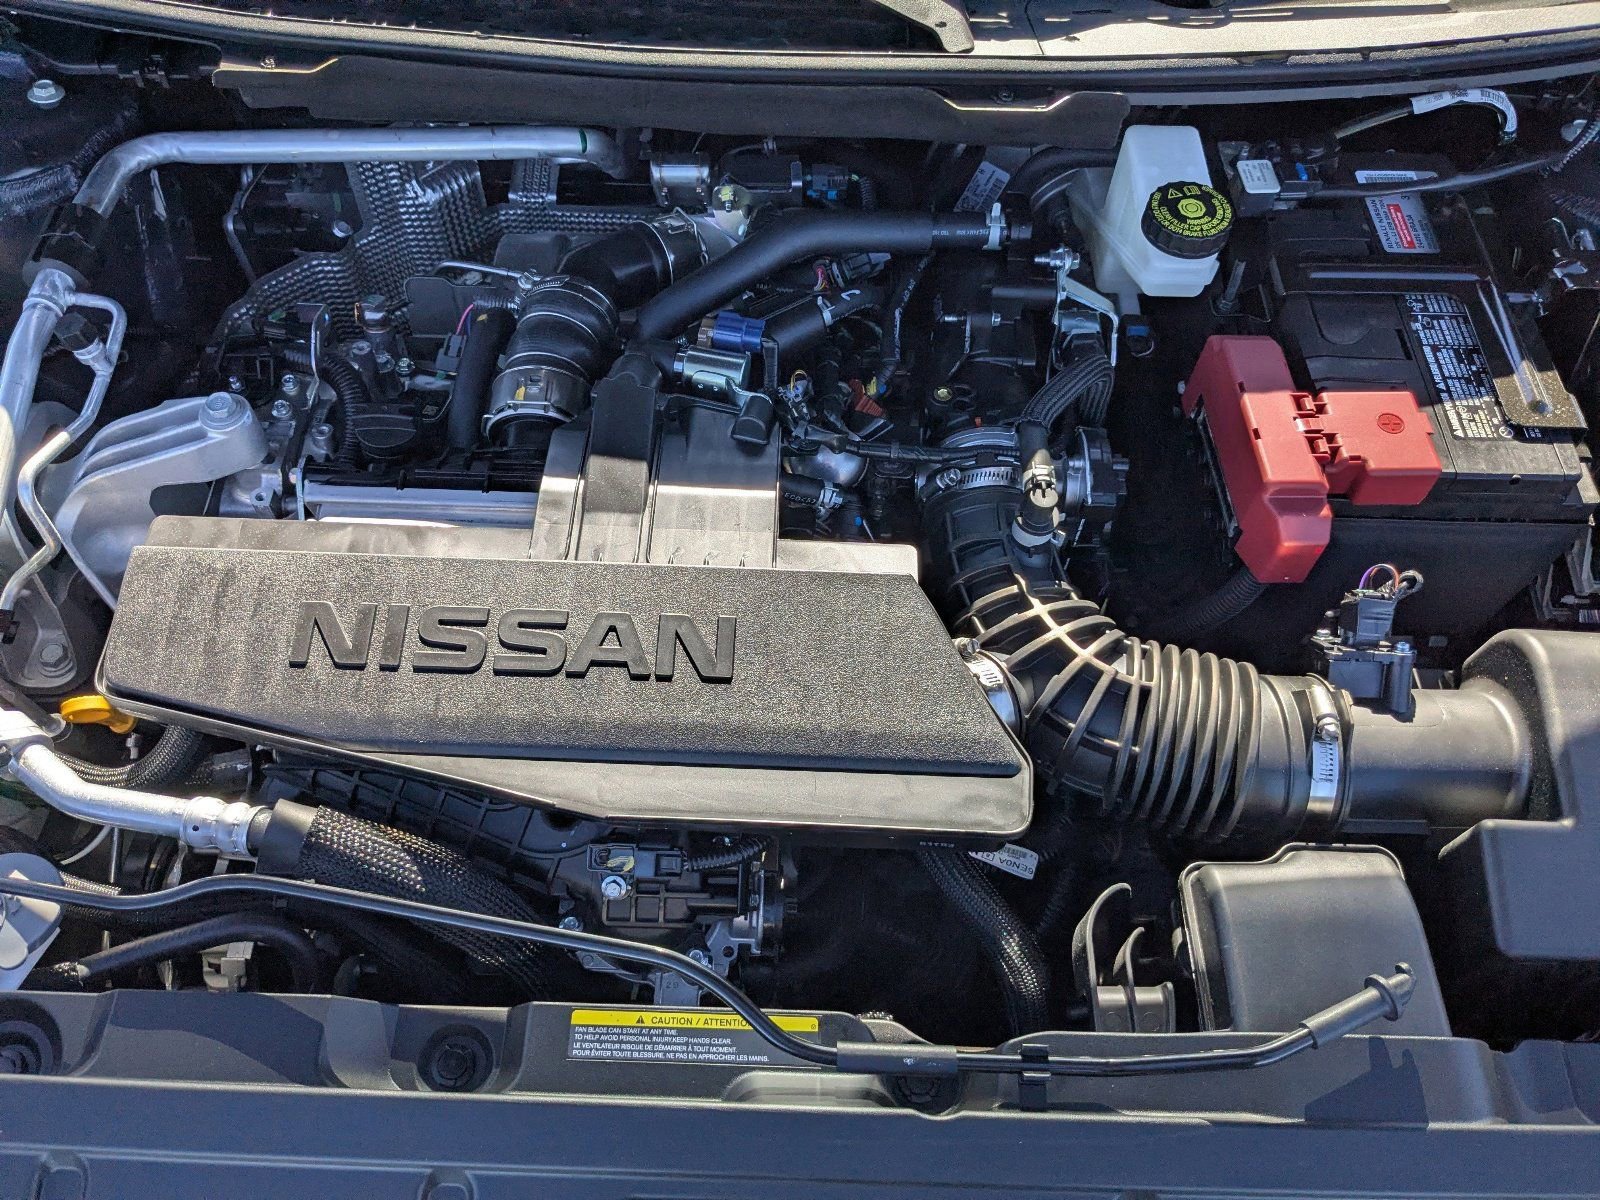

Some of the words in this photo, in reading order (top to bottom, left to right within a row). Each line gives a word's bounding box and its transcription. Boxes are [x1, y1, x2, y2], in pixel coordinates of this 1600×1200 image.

[1369, 199, 1383, 223] NISSAN
[288, 602, 738, 684] NISSAN
[651, 1016, 692, 1025] CAUTION
[703, 1018, 750, 1027] ATTENTIO
